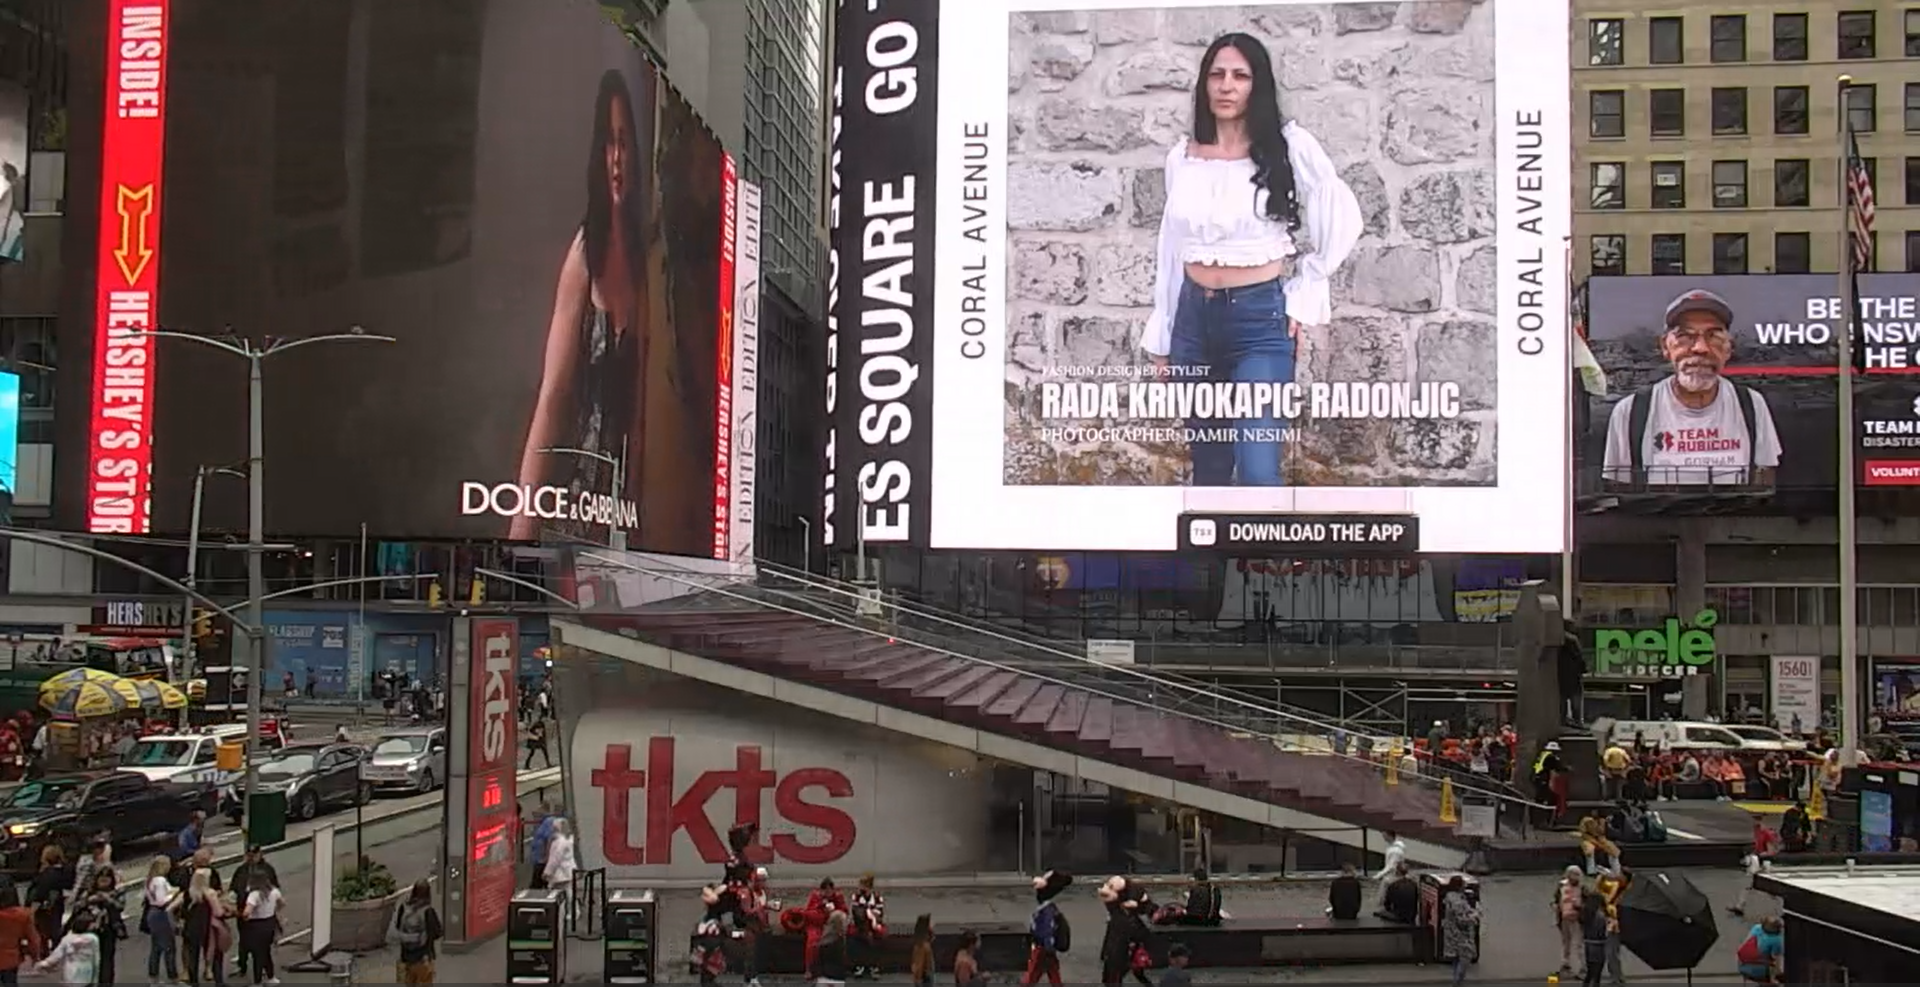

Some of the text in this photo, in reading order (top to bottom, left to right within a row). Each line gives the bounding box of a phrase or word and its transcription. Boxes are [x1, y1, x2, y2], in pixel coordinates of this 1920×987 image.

[119, 6, 162, 118] INSIDE!
[865, 21, 918, 114] GO
[960, 122, 988, 359] CORAL AVENUE
[1515, 109, 1544, 355] CORAL AVENUE
[858, 175, 919, 444] SQUARE
[1859, 298, 1915, 318] THE
[1755, 323, 1830, 344] WHO
[101, 291, 150, 449] HERSHEY'S
[1042, 365, 1211, 377] FASHION DESIGNER/STYLIST
[1042, 382, 1459, 419] RADA KRIVOKAPIC RADONJIC
[1184, 427, 1238, 442] DAMIR
[1243, 427, 1301, 442] NESIMI
[1678, 429, 1719, 440] TEAM
[1678, 439, 1741, 452] RUBICON
[1863, 421, 1913, 434] TEAM
[463, 481, 568, 519] DOLCE
[570, 503, 578, 520] &
[1230, 523, 1404, 542] DOWNLOAD THE APP
[1779, 661, 1807, 676] 1560
[484, 632, 510, 762] tkts
[591, 736, 856, 865] tkts
